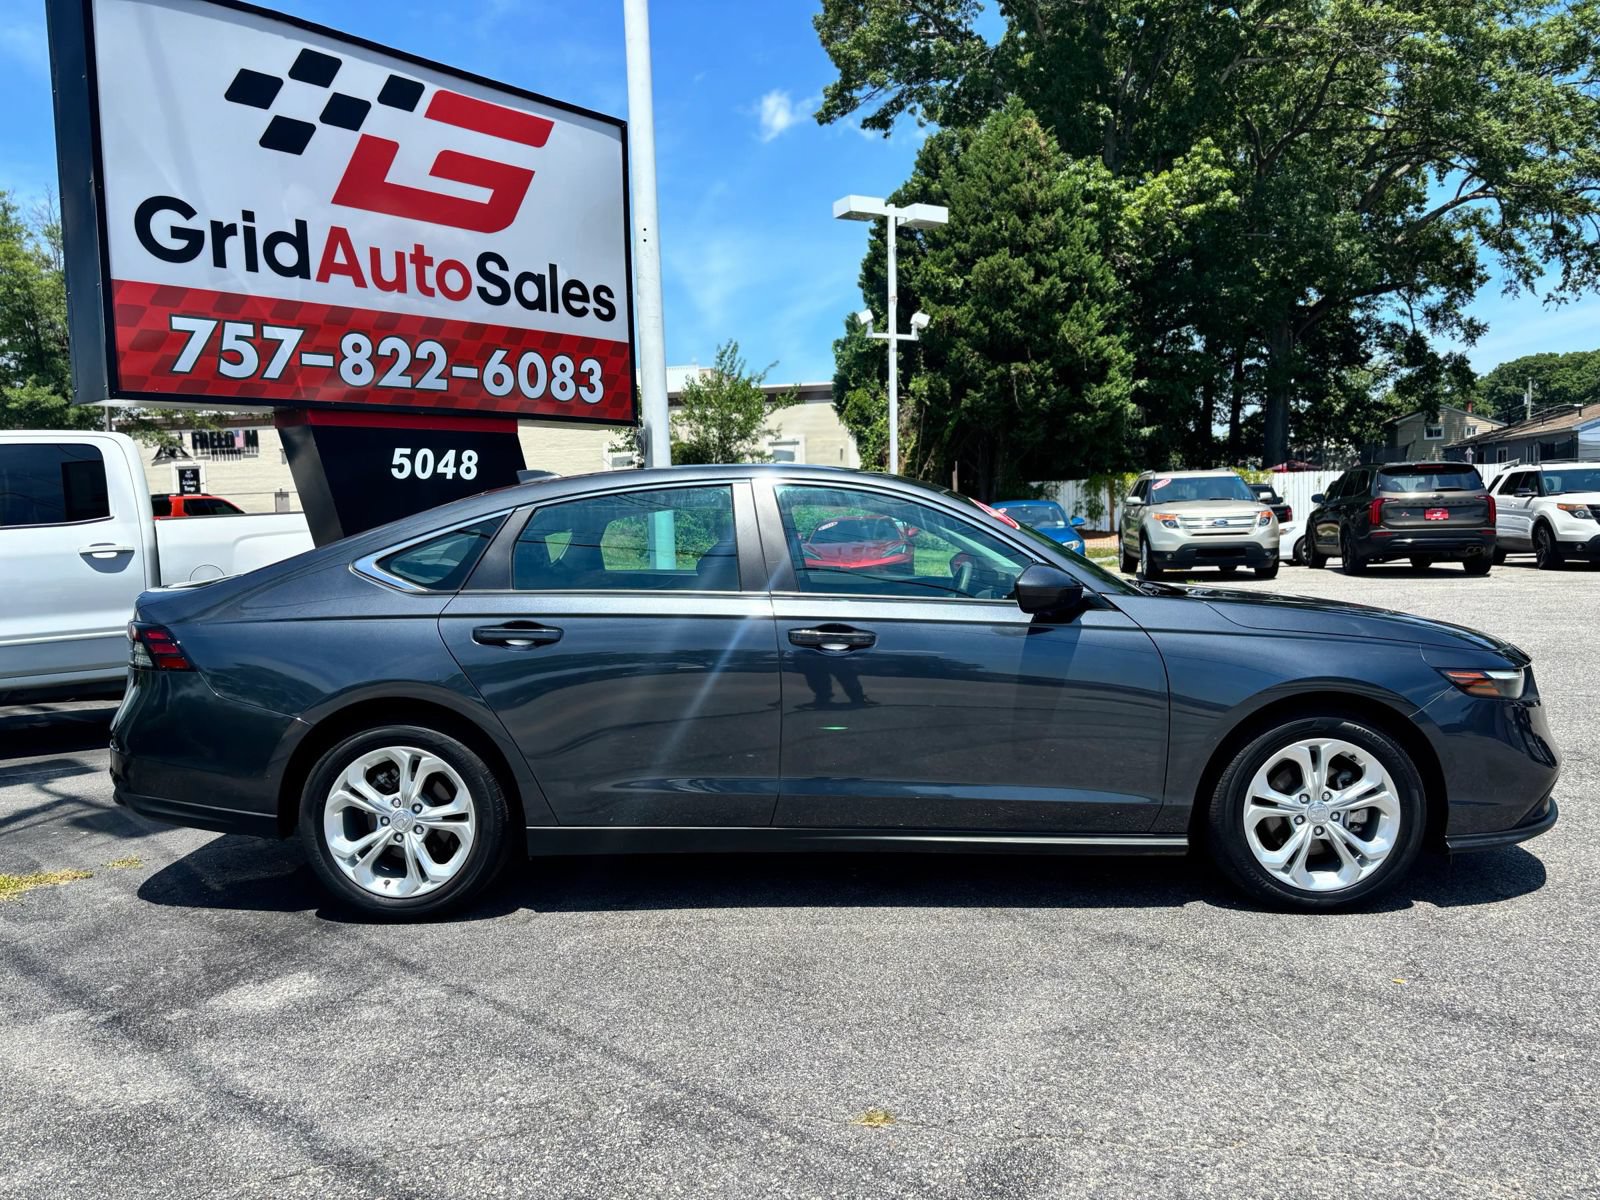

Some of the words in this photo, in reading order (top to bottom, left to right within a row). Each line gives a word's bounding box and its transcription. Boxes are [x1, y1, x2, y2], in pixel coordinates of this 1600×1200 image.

[169, 314, 605, 404] 757-822-6083
[191, 429, 259, 449] FREEDM
[390, 447, 479, 480] 5048
